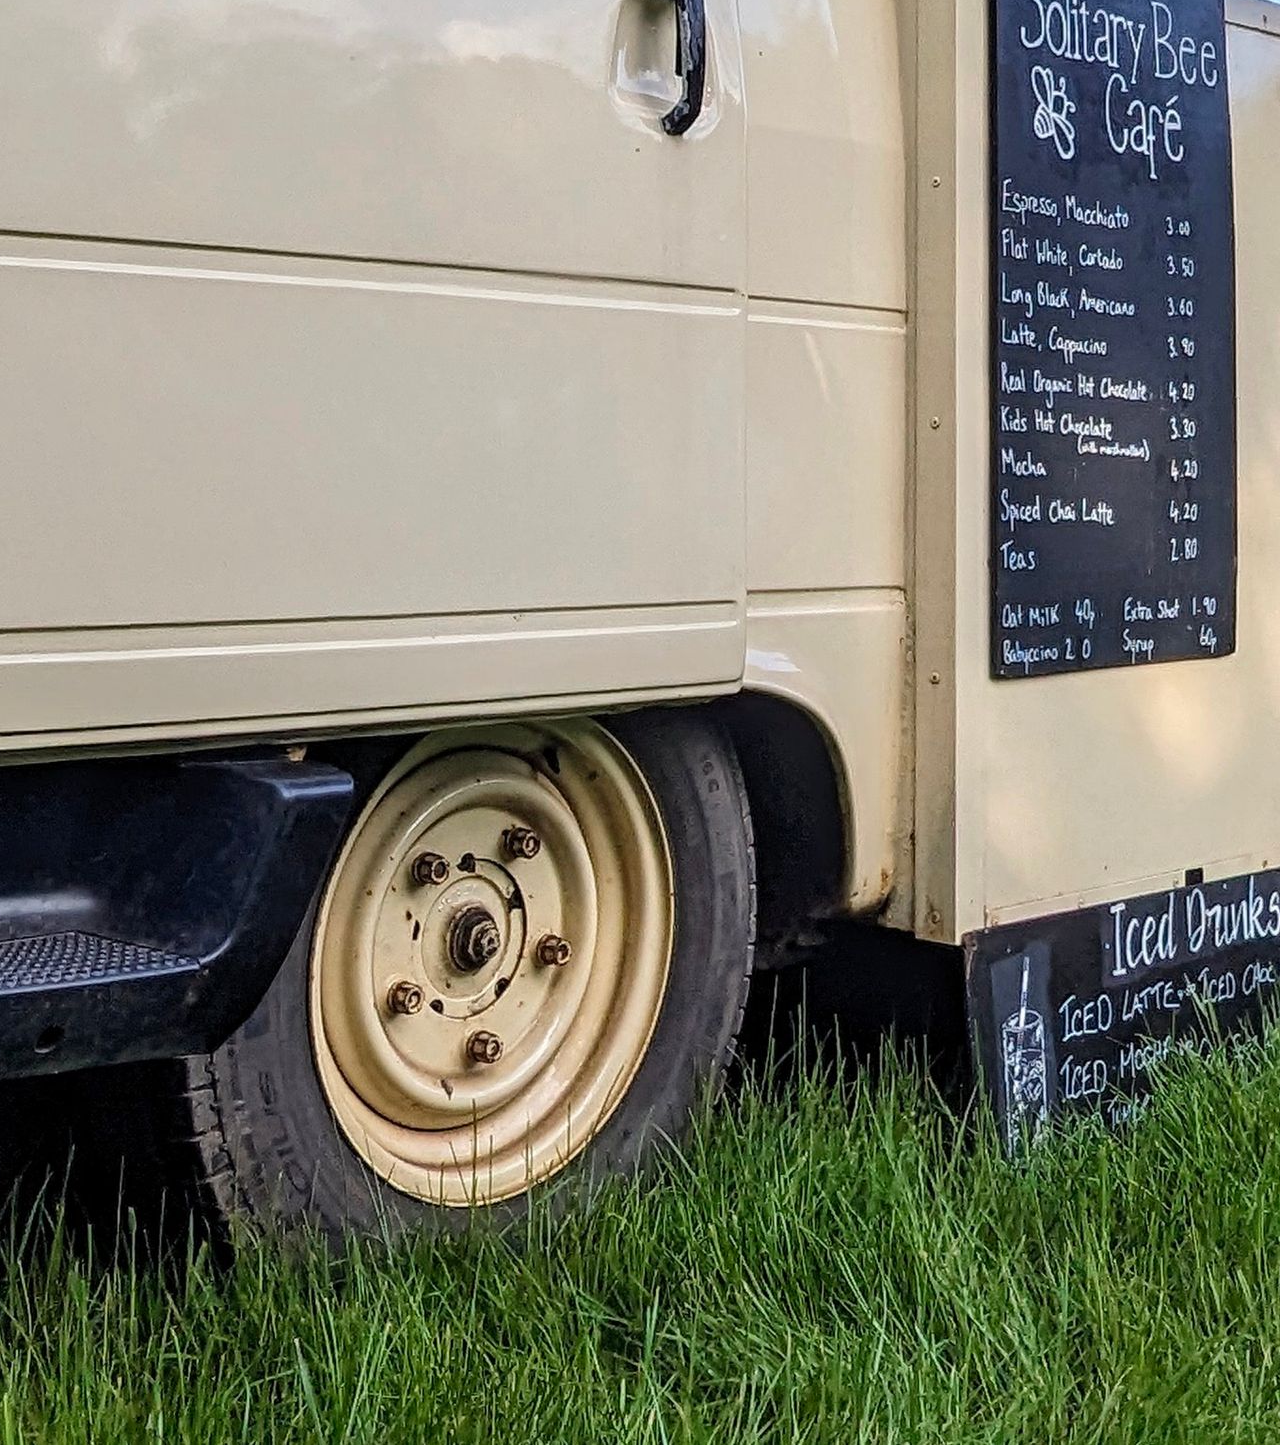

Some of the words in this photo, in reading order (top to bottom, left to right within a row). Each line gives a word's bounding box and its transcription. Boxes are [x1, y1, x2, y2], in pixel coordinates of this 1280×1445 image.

[1151, 1, 1218, 87] Bee
[1106, 73, 1184, 180] Café
[1002, 179, 1061, 226] Espresso,
[1066, 195, 1129, 229] Macchiato
[1002, 229, 1028, 259] Flat
[1036, 239, 1073, 276] White,
[1079, 244, 1123, 270] Cortado
[1002, 272, 1033, 318] Long
[1079, 288, 1135, 316] Americano
[1167, 297, 1194, 317] 3.60
[1002, 317, 1042, 352] Latte,
[1001, 362, 1026, 394] Real
[1033, 369, 1073, 409] Organic
[1078, 373, 1095, 397] Hot
[1169, 381, 1195, 403] 4.20
[1001, 406, 1028, 433] Kids
[1035, 409, 1056, 434] Hot
[1060, 413, 1113, 441] Chocolate
[1171, 418, 1196, 440] 3.30
[1001, 448, 1047, 477] Mocha
[1171, 459, 1198, 482] 4.20
[1000, 488, 1041, 532] Spiced
[1049, 496, 1076, 523] Chai
[1082, 497, 1115, 526] Latte
[1169, 499, 1198, 524] 4.20
[1000, 540, 1036, 570] Teas
[1171, 538, 1198, 562] 2.80
[1002, 604, 1023, 628] Oat
[1124, 597, 1154, 622] Extra
[1157, 598, 1180, 619] Shot
[1003, 639, 1058, 675] Babyccino
[1122, 628, 1154, 665] Syrup
[1109, 891, 1177, 977] Iced
[1059, 994, 1113, 1042] ICED
[1122, 980, 1180, 1022] LATTE
[1197, 966, 1236, 1003] ICED
[1060, 1054, 1107, 1099] ICED
